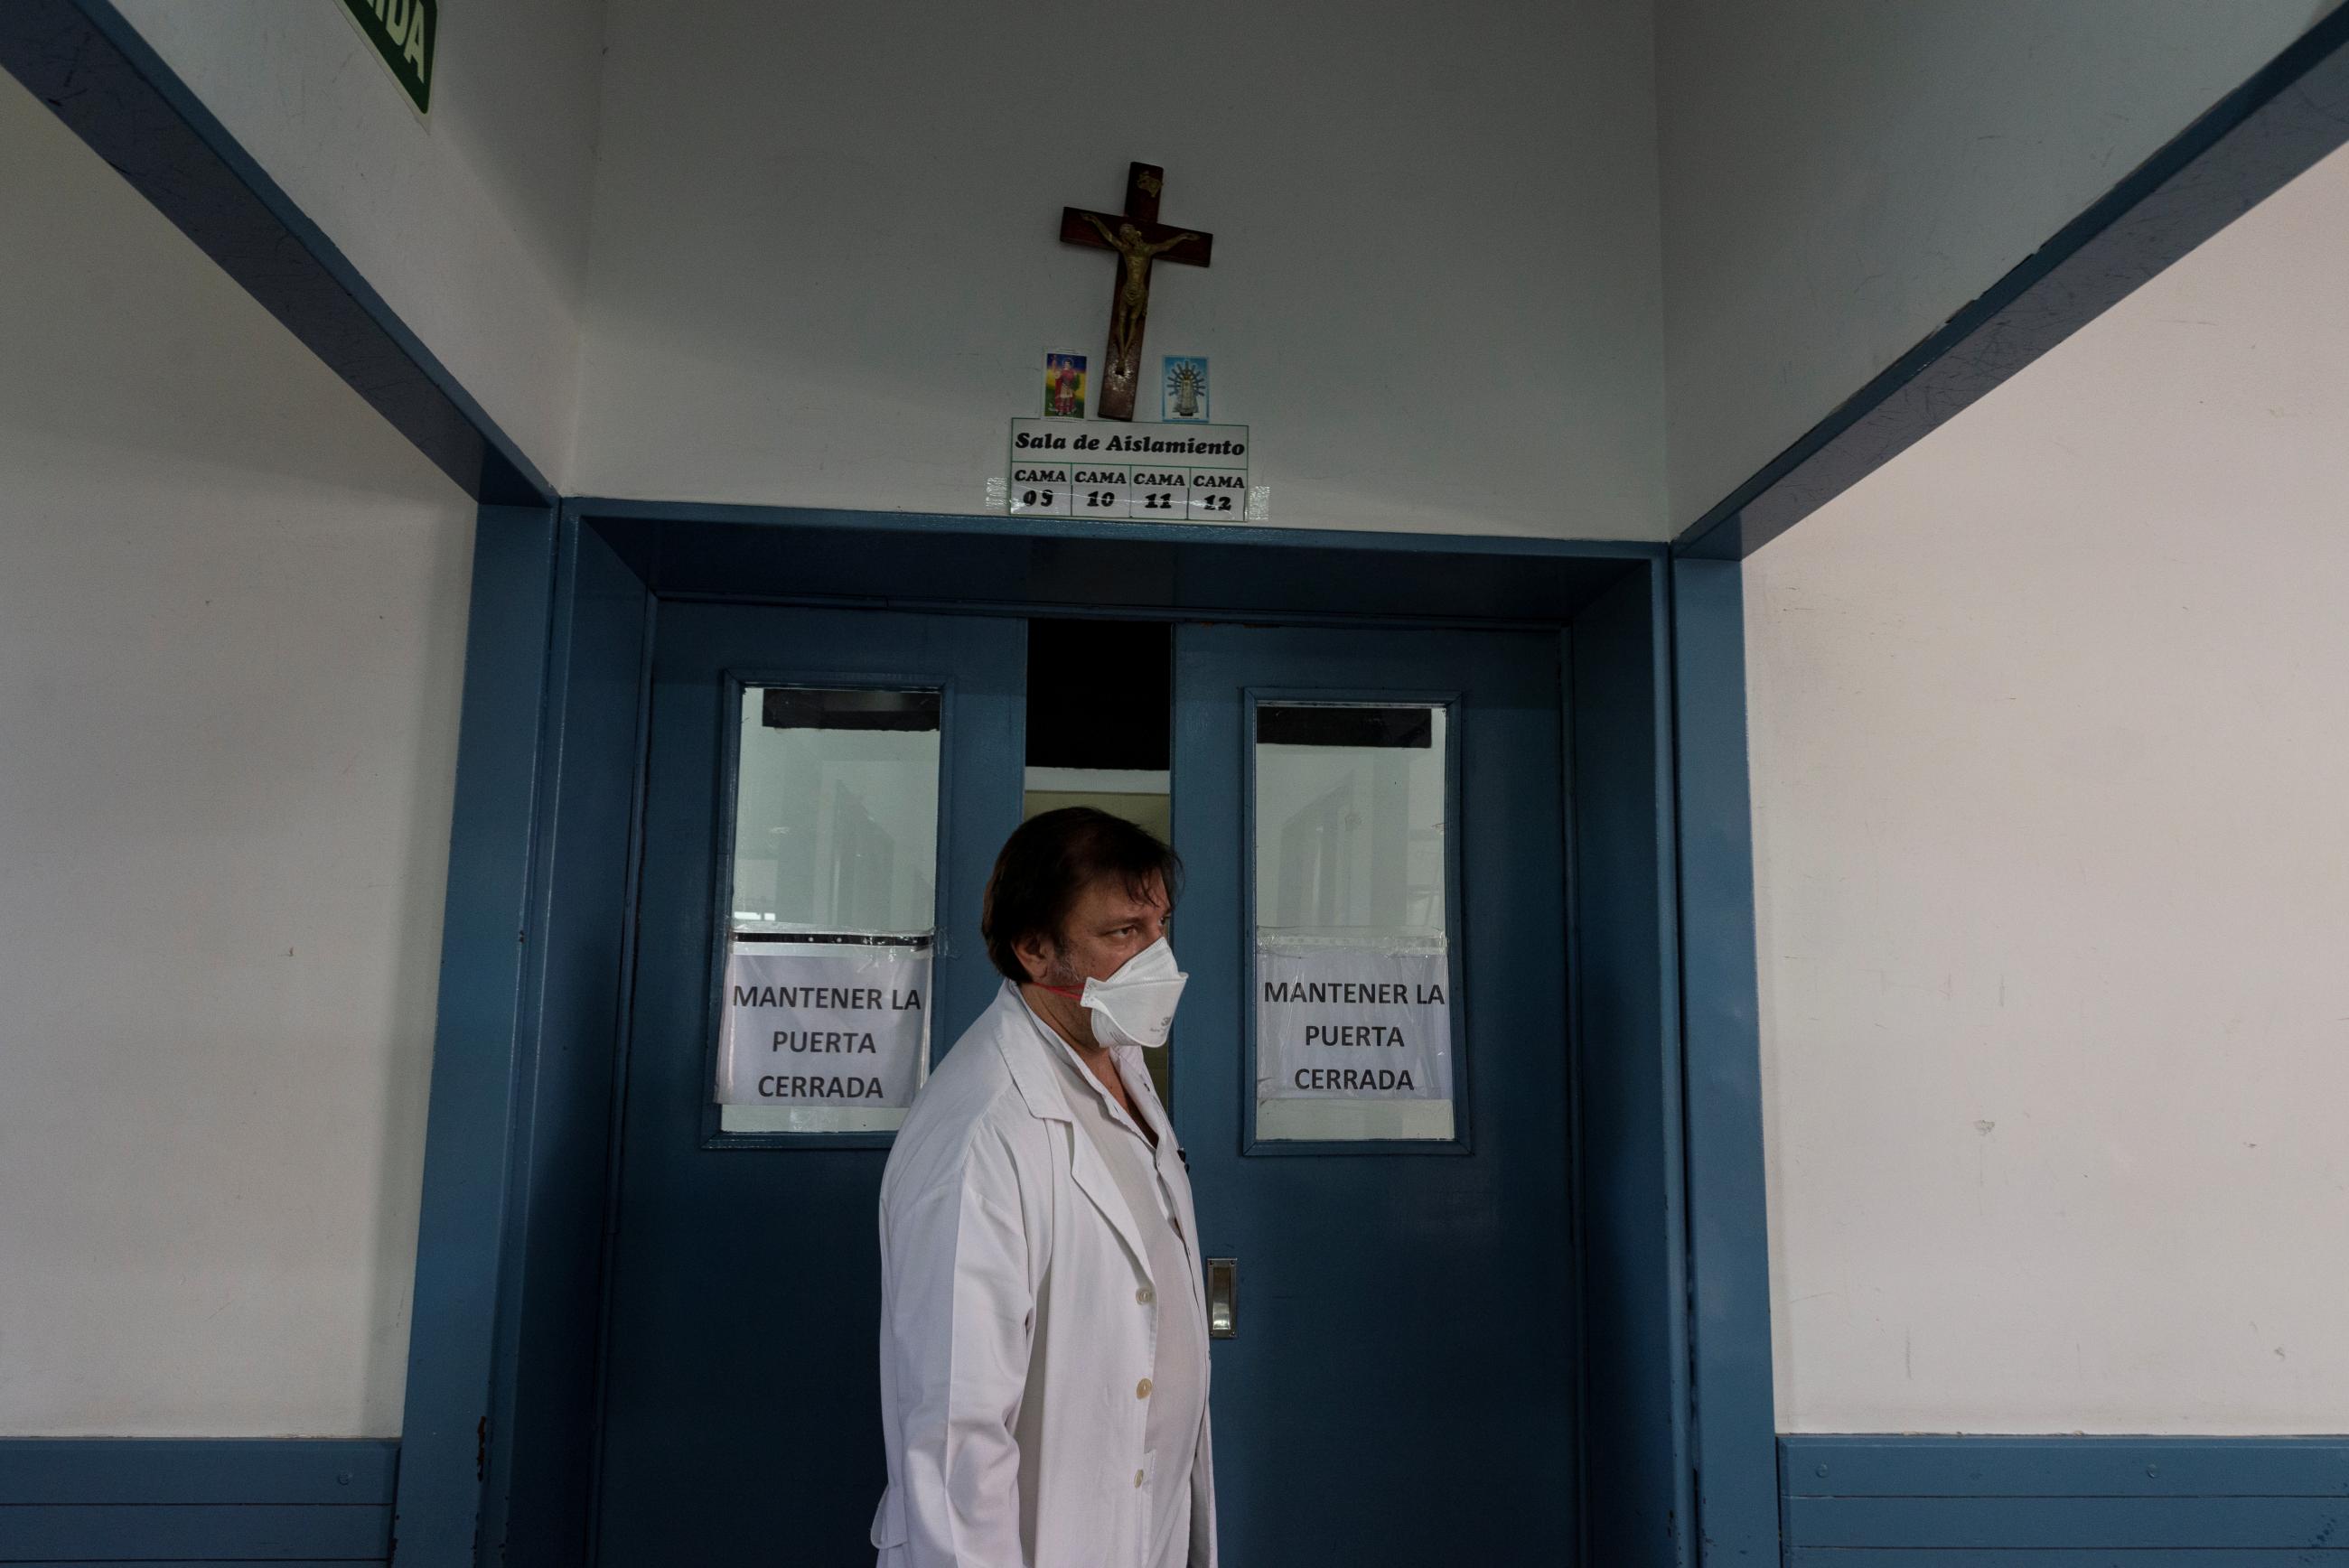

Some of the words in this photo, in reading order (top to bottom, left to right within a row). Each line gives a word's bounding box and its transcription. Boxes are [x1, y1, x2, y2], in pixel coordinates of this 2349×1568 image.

[1015, 433, 1066, 449] Sala
[1073, 434, 1100, 451] de
[1105, 435, 1245, 455] Aislamiento
[1014, 470, 1067, 481] CAMA
[1074, 471, 1127, 484] CAMA
[1133, 473, 1185, 486] CAMA
[1193, 475, 1245, 489] CAMA
[1087, 490, 1115, 507] 10
[1145, 493, 1172, 509] 11
[1203, 494, 1231, 510] 12
[733, 985, 883, 1010] MANTENER
[892, 989, 922, 1011] LA
[1265, 982, 1408, 1004] MANTENER
[1417, 984, 1446, 1005] LA
[772, 1031, 876, 1054] PUERTA
[1306, 1025, 1405, 1048] PUERTA
[758, 1075, 884, 1099] CERRADA
[1295, 1069, 1415, 1091] CERRADA
